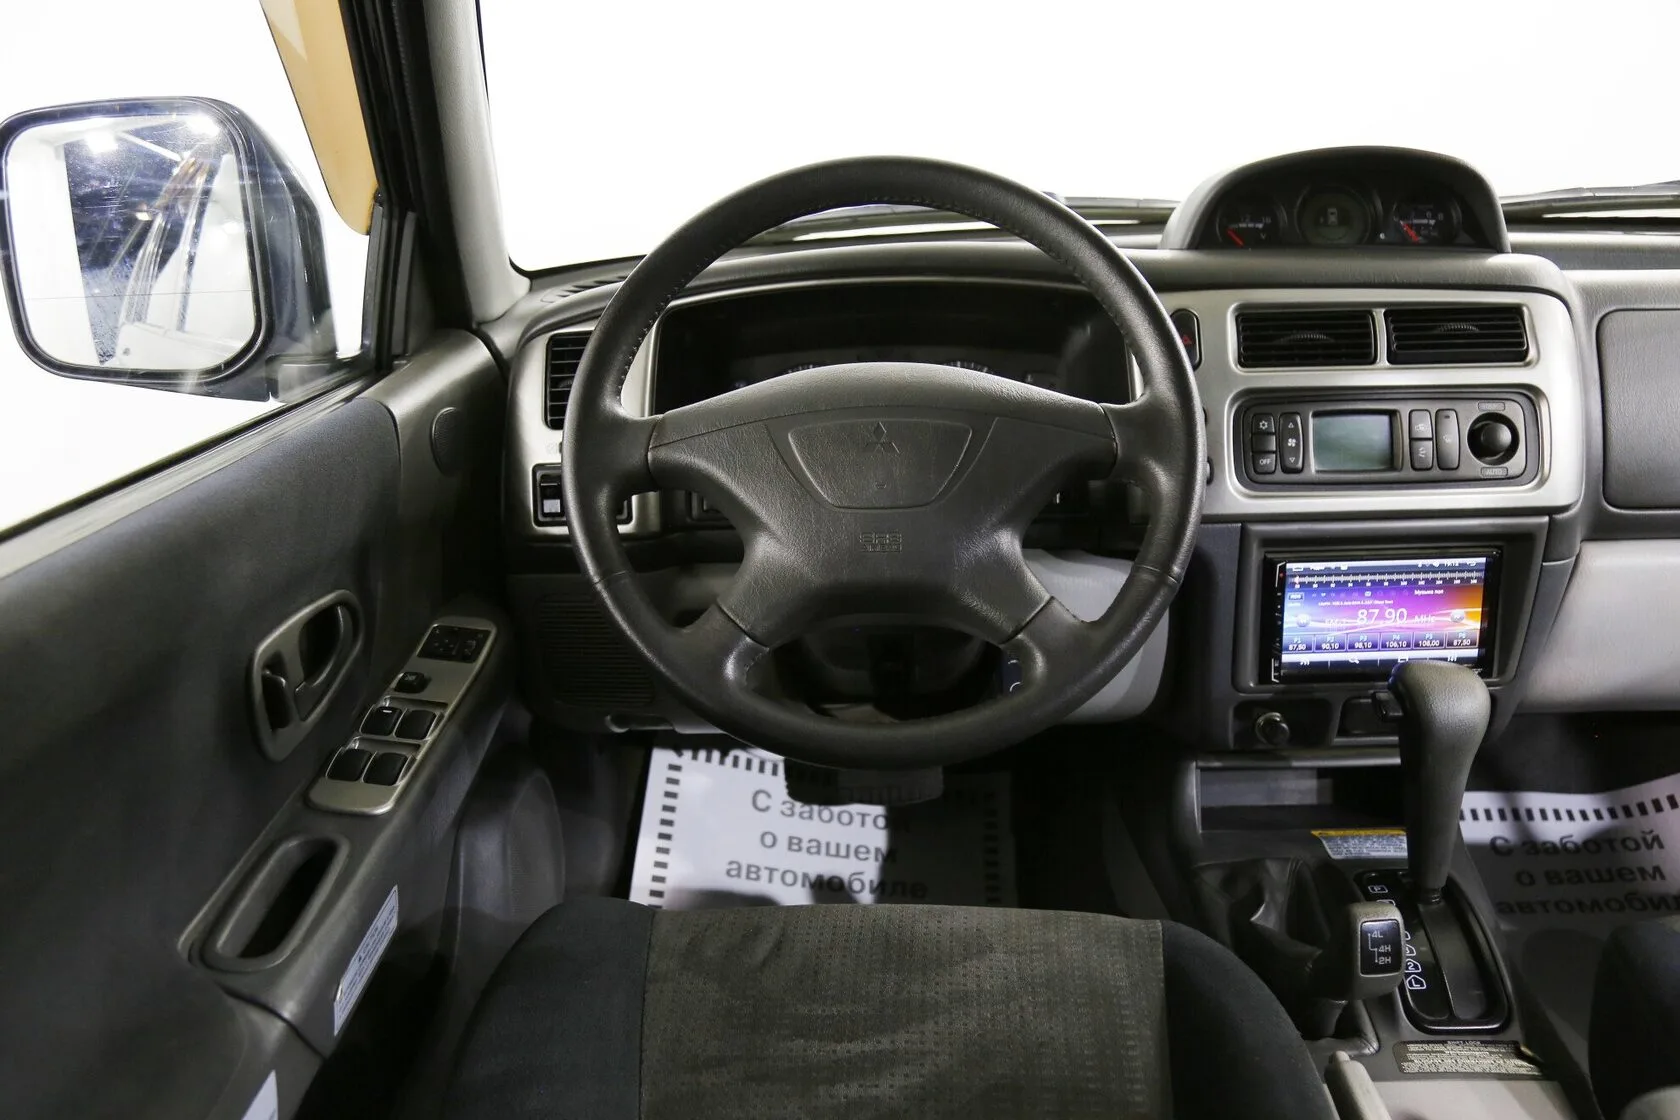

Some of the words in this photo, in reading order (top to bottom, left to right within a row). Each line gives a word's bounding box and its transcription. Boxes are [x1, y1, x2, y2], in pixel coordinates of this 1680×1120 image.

[752, 789, 773, 813] С
[760, 833, 778, 850] о
[786, 837, 898, 865] вашем
[1489, 835, 1514, 857] С
[1522, 829, 1665, 856] заботой
[726, 859, 929, 900] автомобиле
[1516, 868, 1536, 887] о
[1544, 864, 1666, 886] вашем
[1371, 930, 1384, 939] 4L
[1378, 944, 1392, 953] 4H
[1378, 956, 1392, 965] 2H
[1407, 963, 1416, 971] 2
[1412, 978, 1421, 987] L
